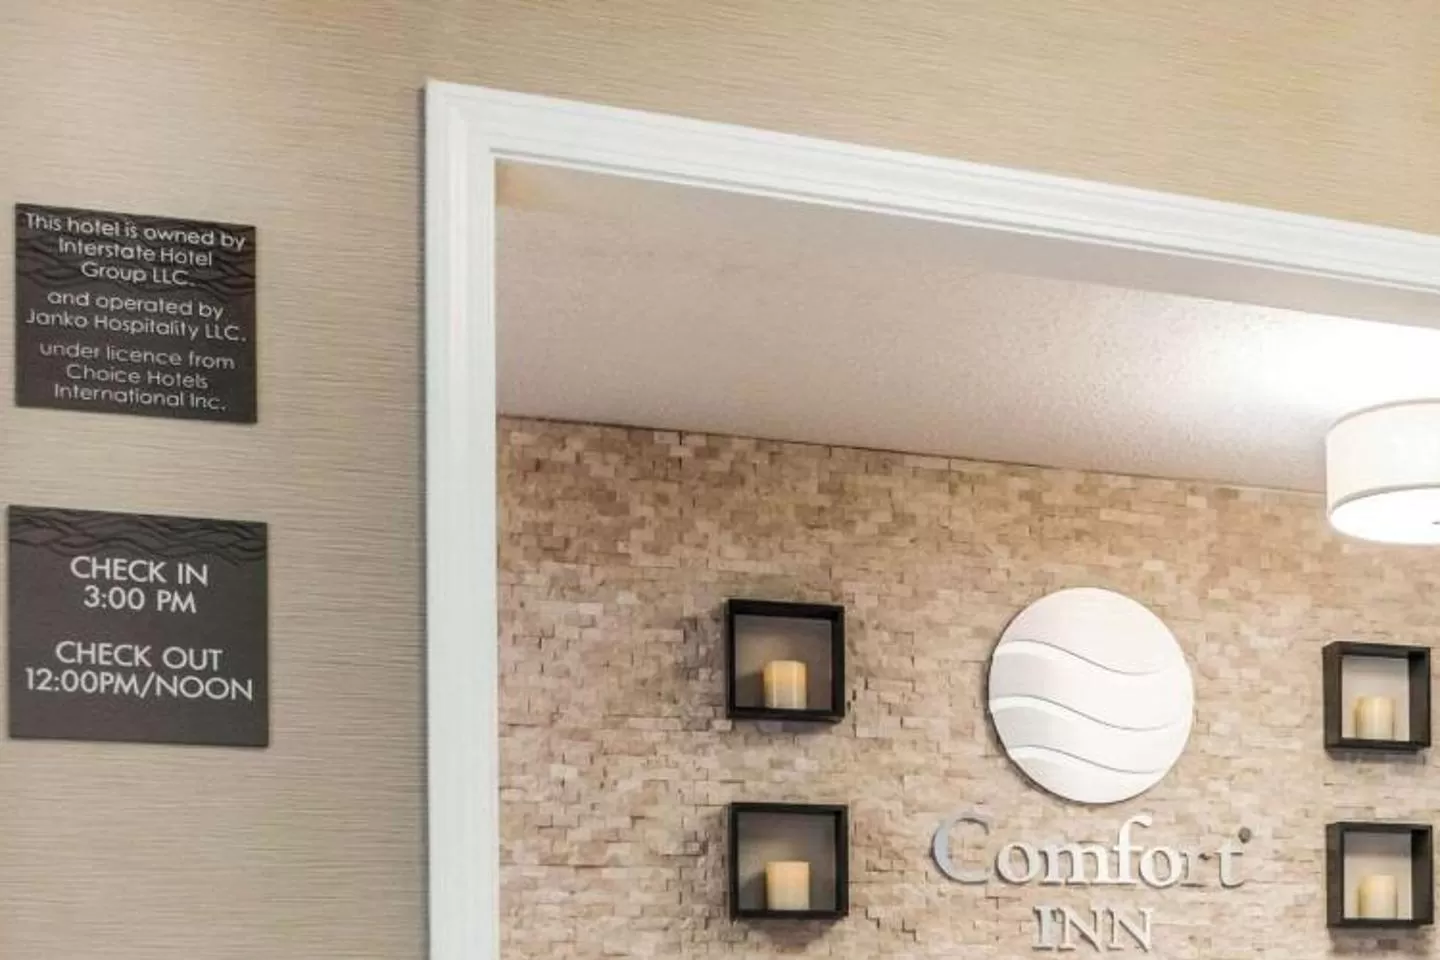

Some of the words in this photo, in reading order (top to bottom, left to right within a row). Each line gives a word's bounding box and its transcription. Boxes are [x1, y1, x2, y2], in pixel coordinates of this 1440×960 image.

[26, 213, 61, 231] This
[68, 217, 119, 237] hotel
[125, 221, 137, 239] is
[144, 227, 214, 245] owned
[221, 231, 246, 250] by
[59, 239, 155, 261] Interstate
[161, 249, 212, 266] Hotel
[81, 262, 146, 282] Group
[48, 292, 89, 306] and
[96, 296, 193, 315] operated
[199, 301, 223, 320] by
[26, 309, 88, 328] Janko
[95, 315, 198, 340] Hospitality
[40, 342, 99, 358] under
[107, 345, 182, 366] licence
[189, 351, 235, 369] from
[67, 364, 140, 383] Choice
[148, 371, 208, 389] Hotels
[55, 384, 183, 407] International
[190, 392, 225, 410] Inc.
[70, 556, 167, 583] CHECK
[178, 563, 208, 586] IN
[84, 585, 145, 610] 3:00
[157, 590, 197, 614] PM
[56, 641, 152, 667] CHECK
[162, 647, 223, 671] OUT
[25, 667, 253, 701] 12:00PM/NOON
[930, 816, 1246, 889] Comfort
[1032, 904, 1154, 953] INN
